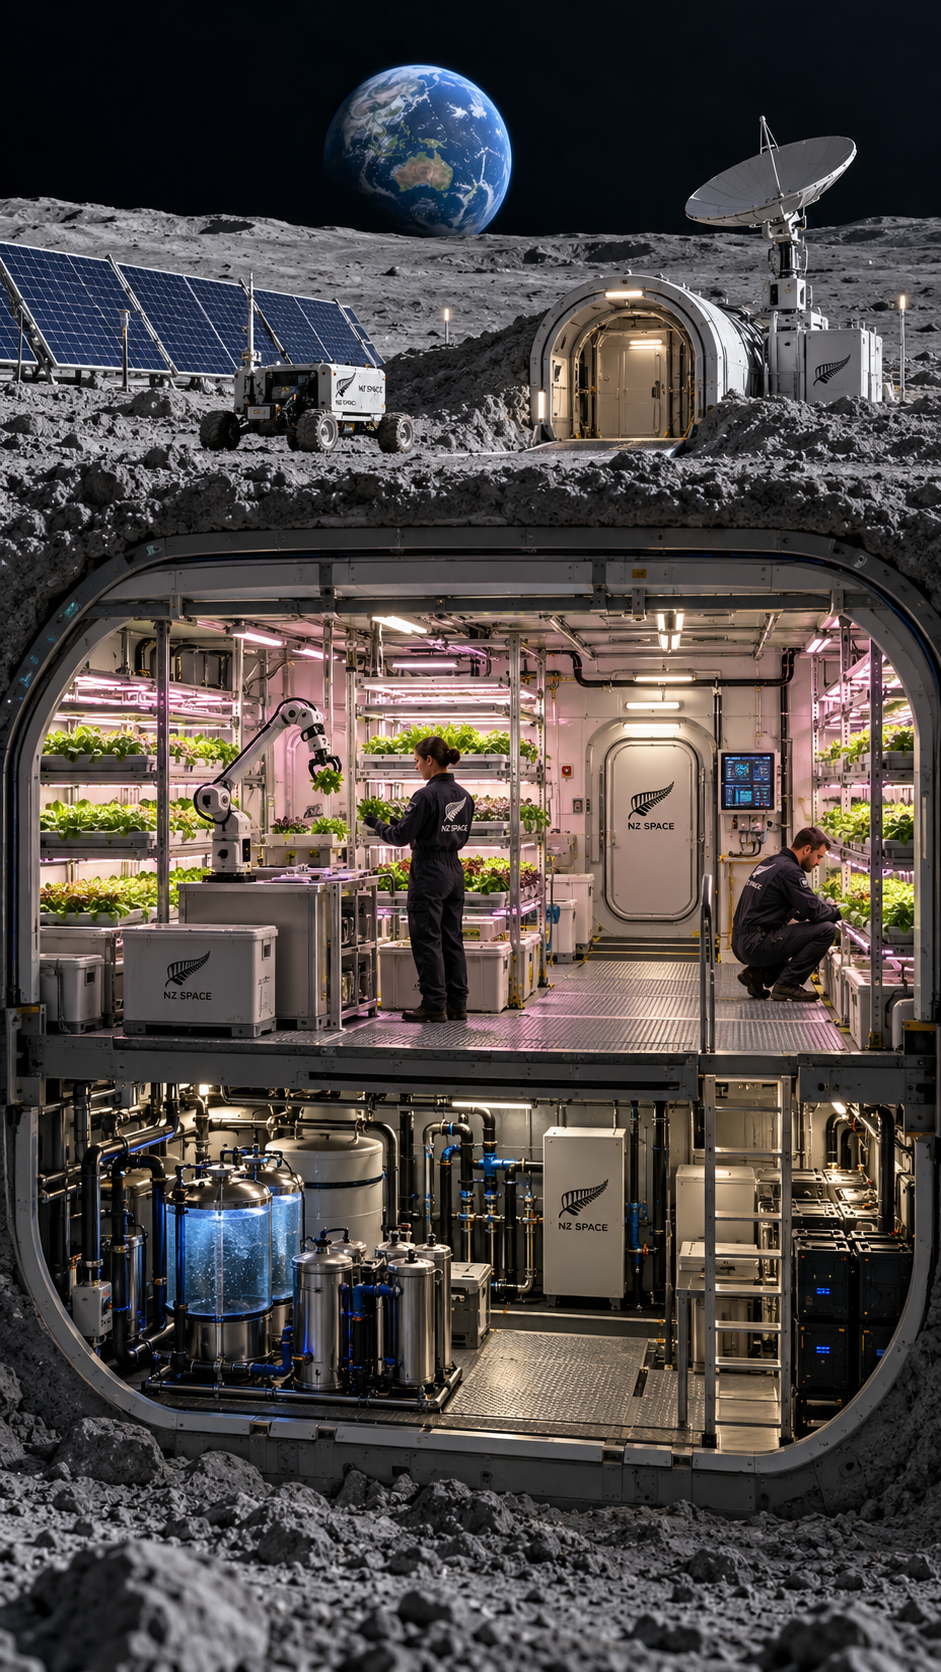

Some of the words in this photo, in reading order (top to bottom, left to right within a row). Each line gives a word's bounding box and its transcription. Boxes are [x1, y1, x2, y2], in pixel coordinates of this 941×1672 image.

[451, 824, 468, 832] SPACE
[628, 822, 641, 830] NZ
[644, 822, 675, 830] SPACE
[163, 991, 177, 1000] NZ
[180, 991, 212, 1001] SPACE
[558, 1222, 572, 1231] NZ
[575, 1222, 608, 1232] SPACE
